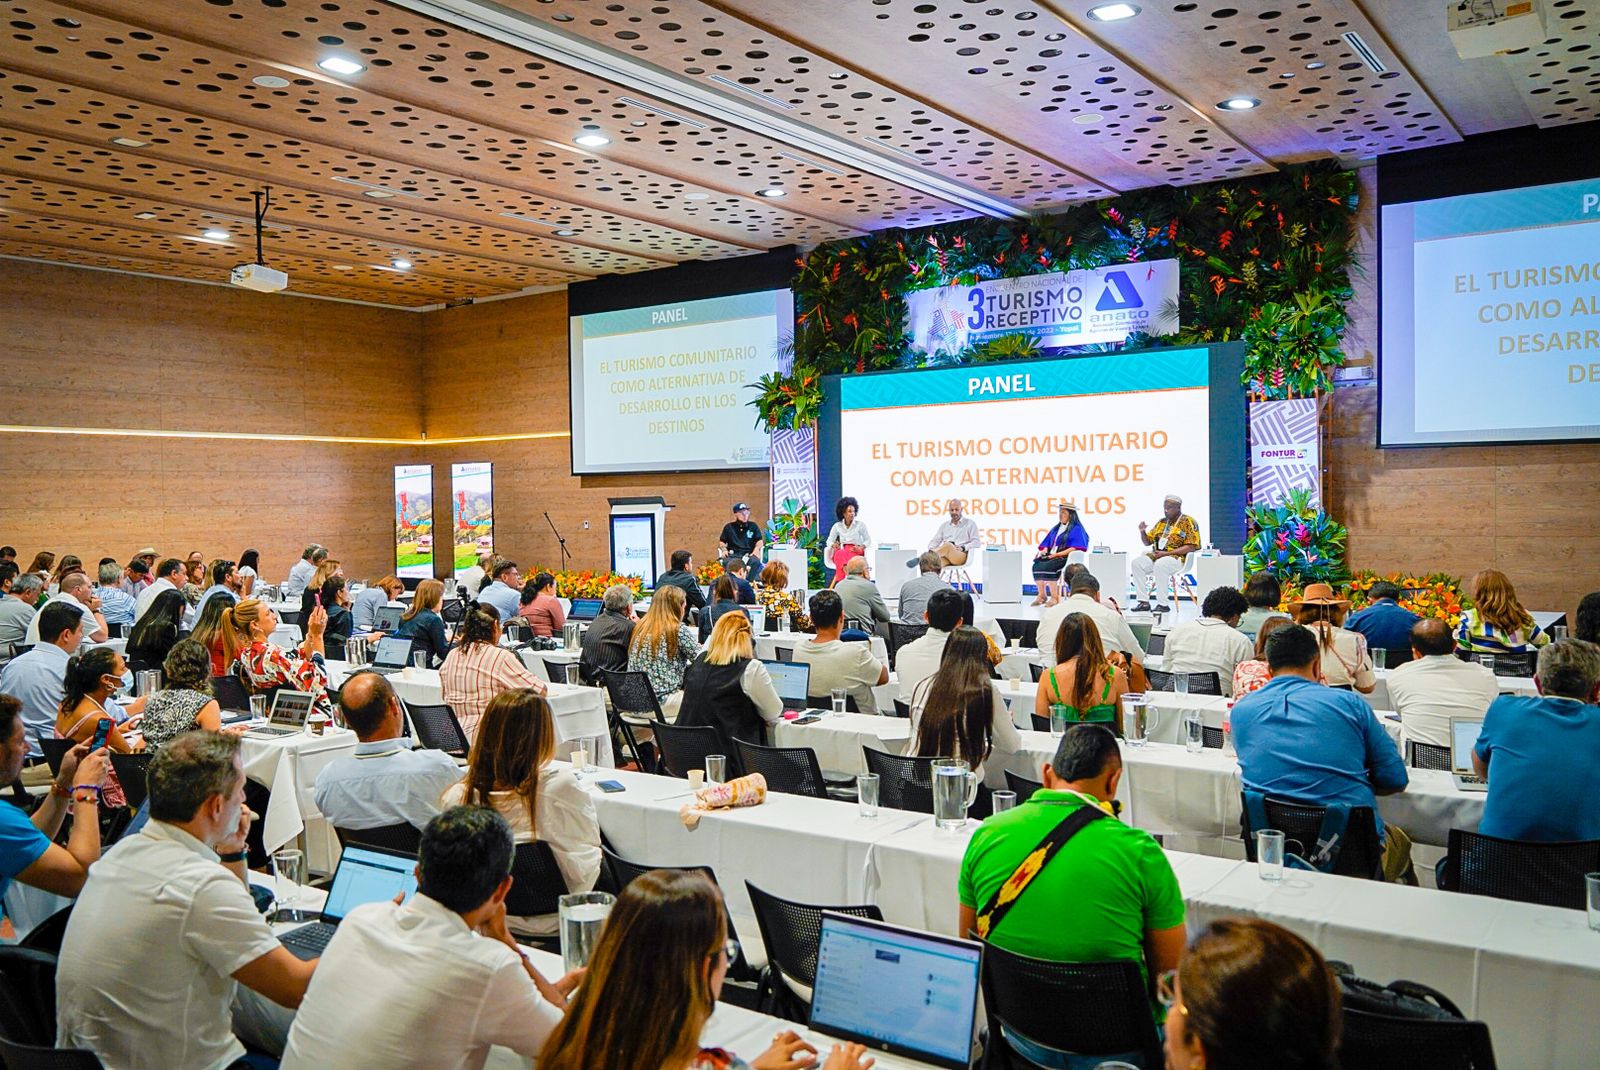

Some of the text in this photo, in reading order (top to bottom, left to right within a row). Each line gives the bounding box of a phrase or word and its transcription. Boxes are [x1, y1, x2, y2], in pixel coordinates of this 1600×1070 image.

[1582, 193, 1600, 214] P
[1454, 274, 1480, 294] EL
[967, 287, 985, 330] 3
[985, 286, 1082, 312] TURISMO
[651, 307, 689, 325] PANEL
[985, 305, 1082, 329] RECEPTIVO
[1089, 310, 1149, 323] anato
[1477, 298, 1562, 324] COMO
[599, 345, 757, 375] EL TURISMO COMUNITARIO
[610, 369, 746, 394] COMO ALTERNATIVA DE
[967, 373, 1036, 396] PANEL
[619, 393, 737, 415] DESARROLLO EN LOS
[648, 418, 705, 435] DESTINOS
[871, 430, 1169, 460] EL TURISMO COMUNITARIO
[1260, 449, 1296, 458] FONTUR
[890, 463, 1145, 488] COMO ALTERNATIVA DE
[1084, 496, 1126, 515] LOS
